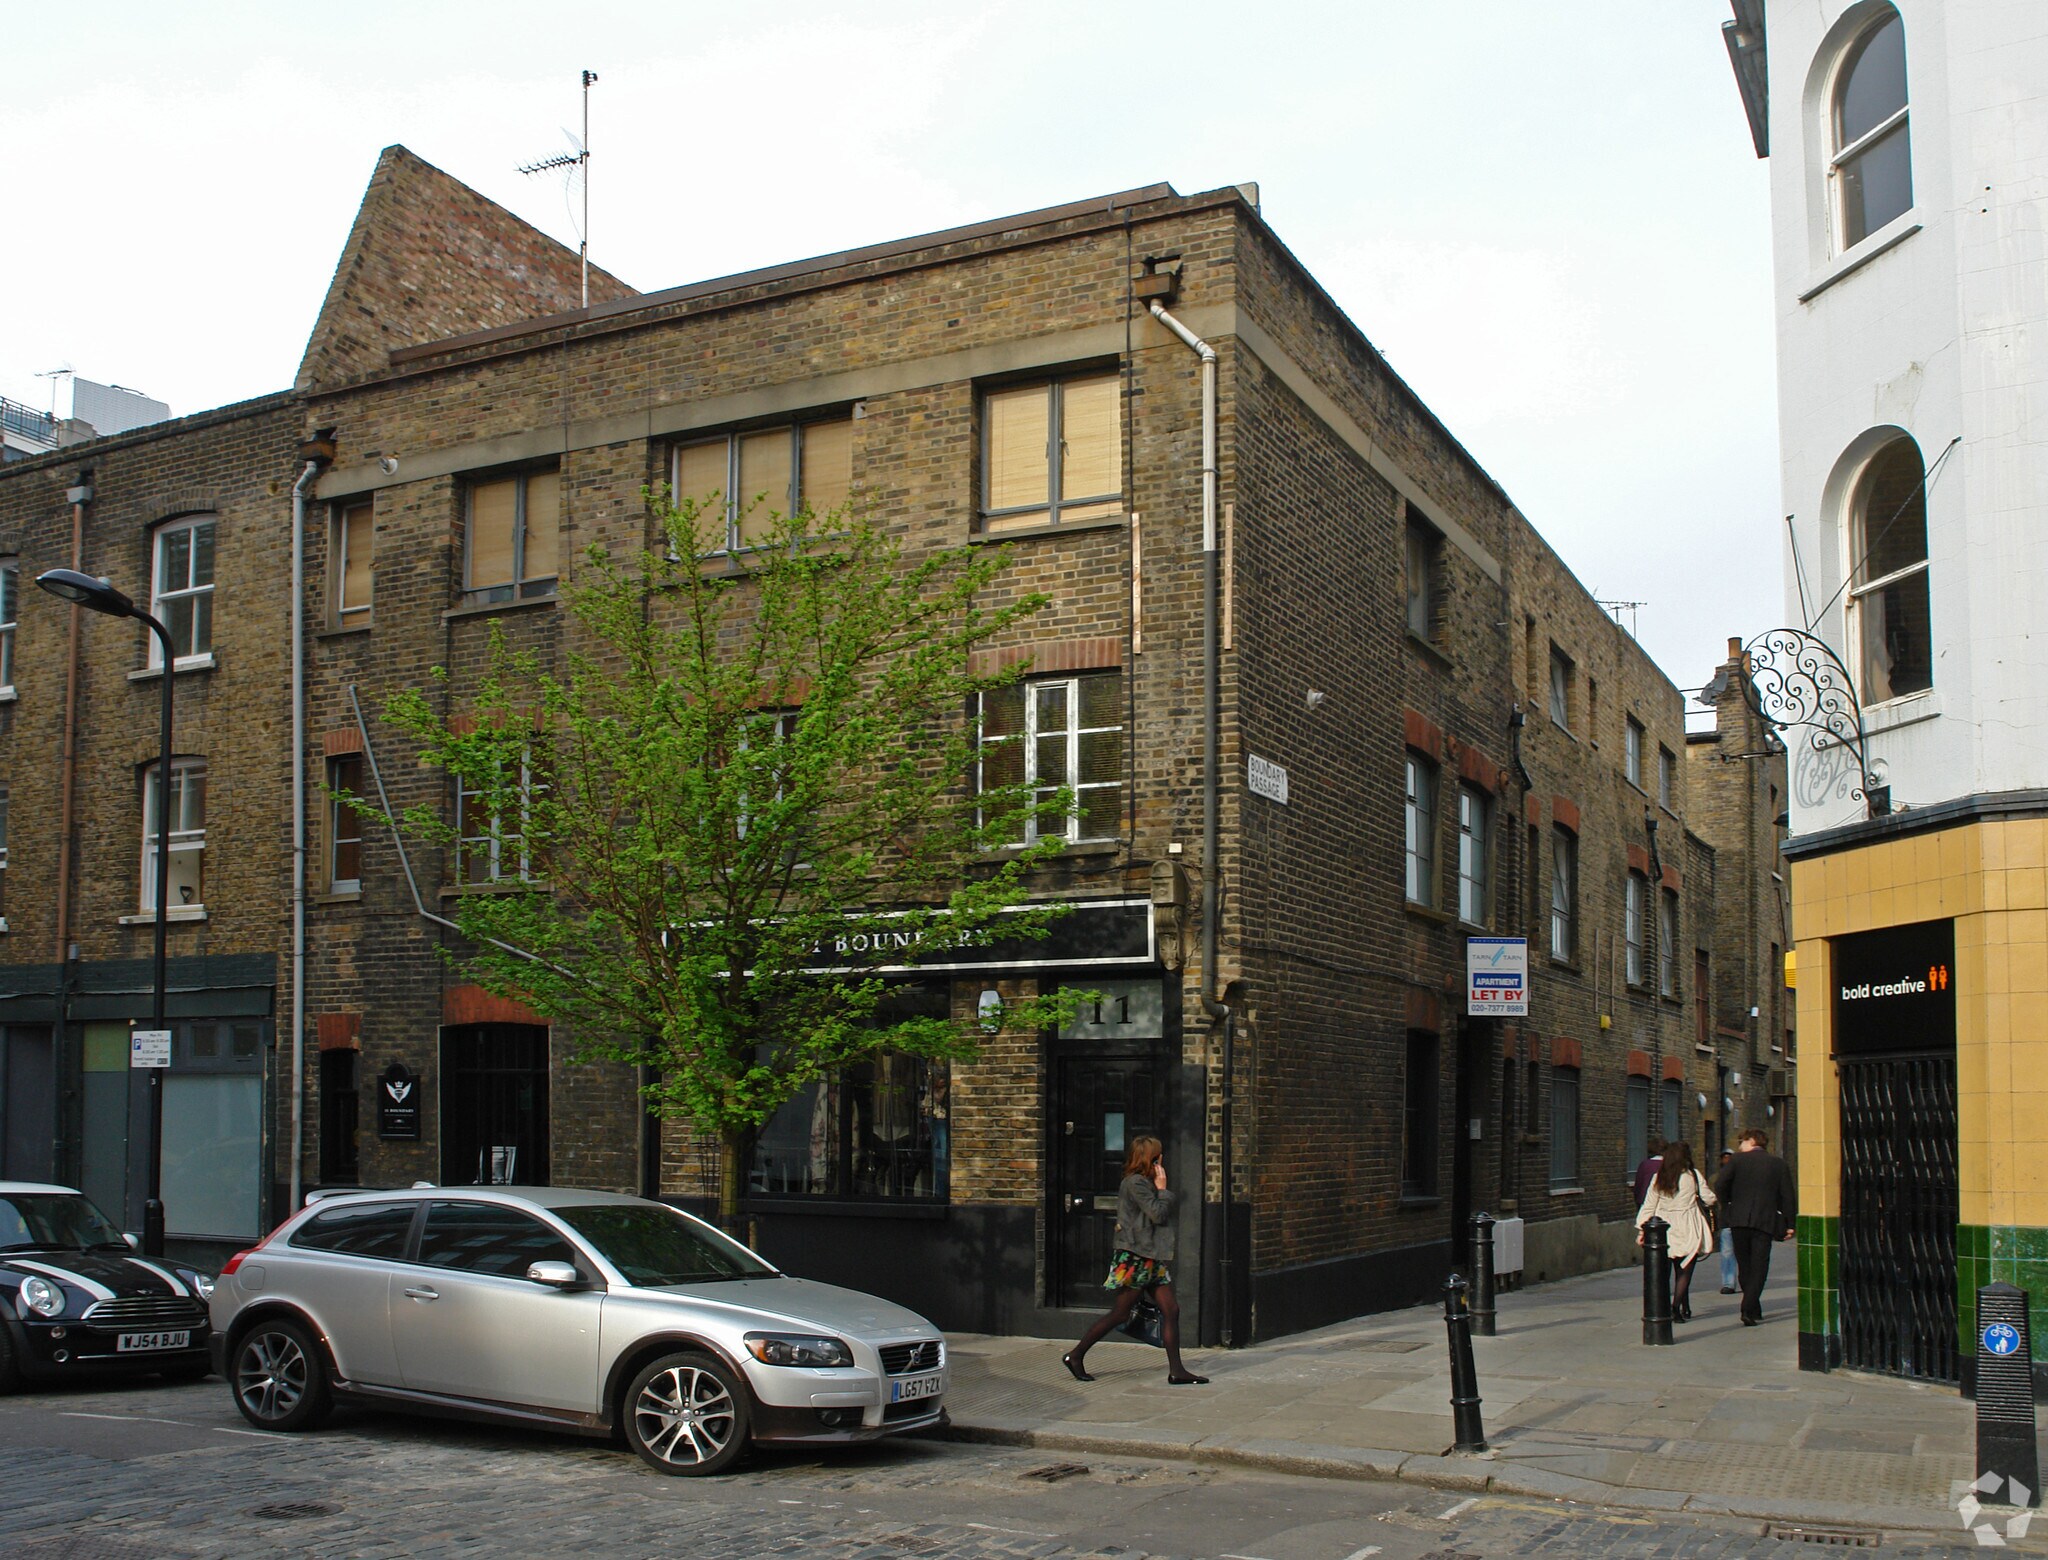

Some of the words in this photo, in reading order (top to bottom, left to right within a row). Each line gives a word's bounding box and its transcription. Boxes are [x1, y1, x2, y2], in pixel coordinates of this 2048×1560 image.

[1250, 756, 1286, 785] BOUNDARY
[1250, 773, 1281, 799] PASSAGE
[1475, 977, 1520, 986] APARTMENT
[1841, 983, 1871, 1001] bold
[1872, 975, 1927, 998] creative
[1471, 989, 1500, 1001] LET
[1504, 989, 1524, 1001] BY
[124, 1334, 159, 1349] WJ54
[161, 1332, 186, 1347] BJU
[899, 1379, 923, 1399] LG57
